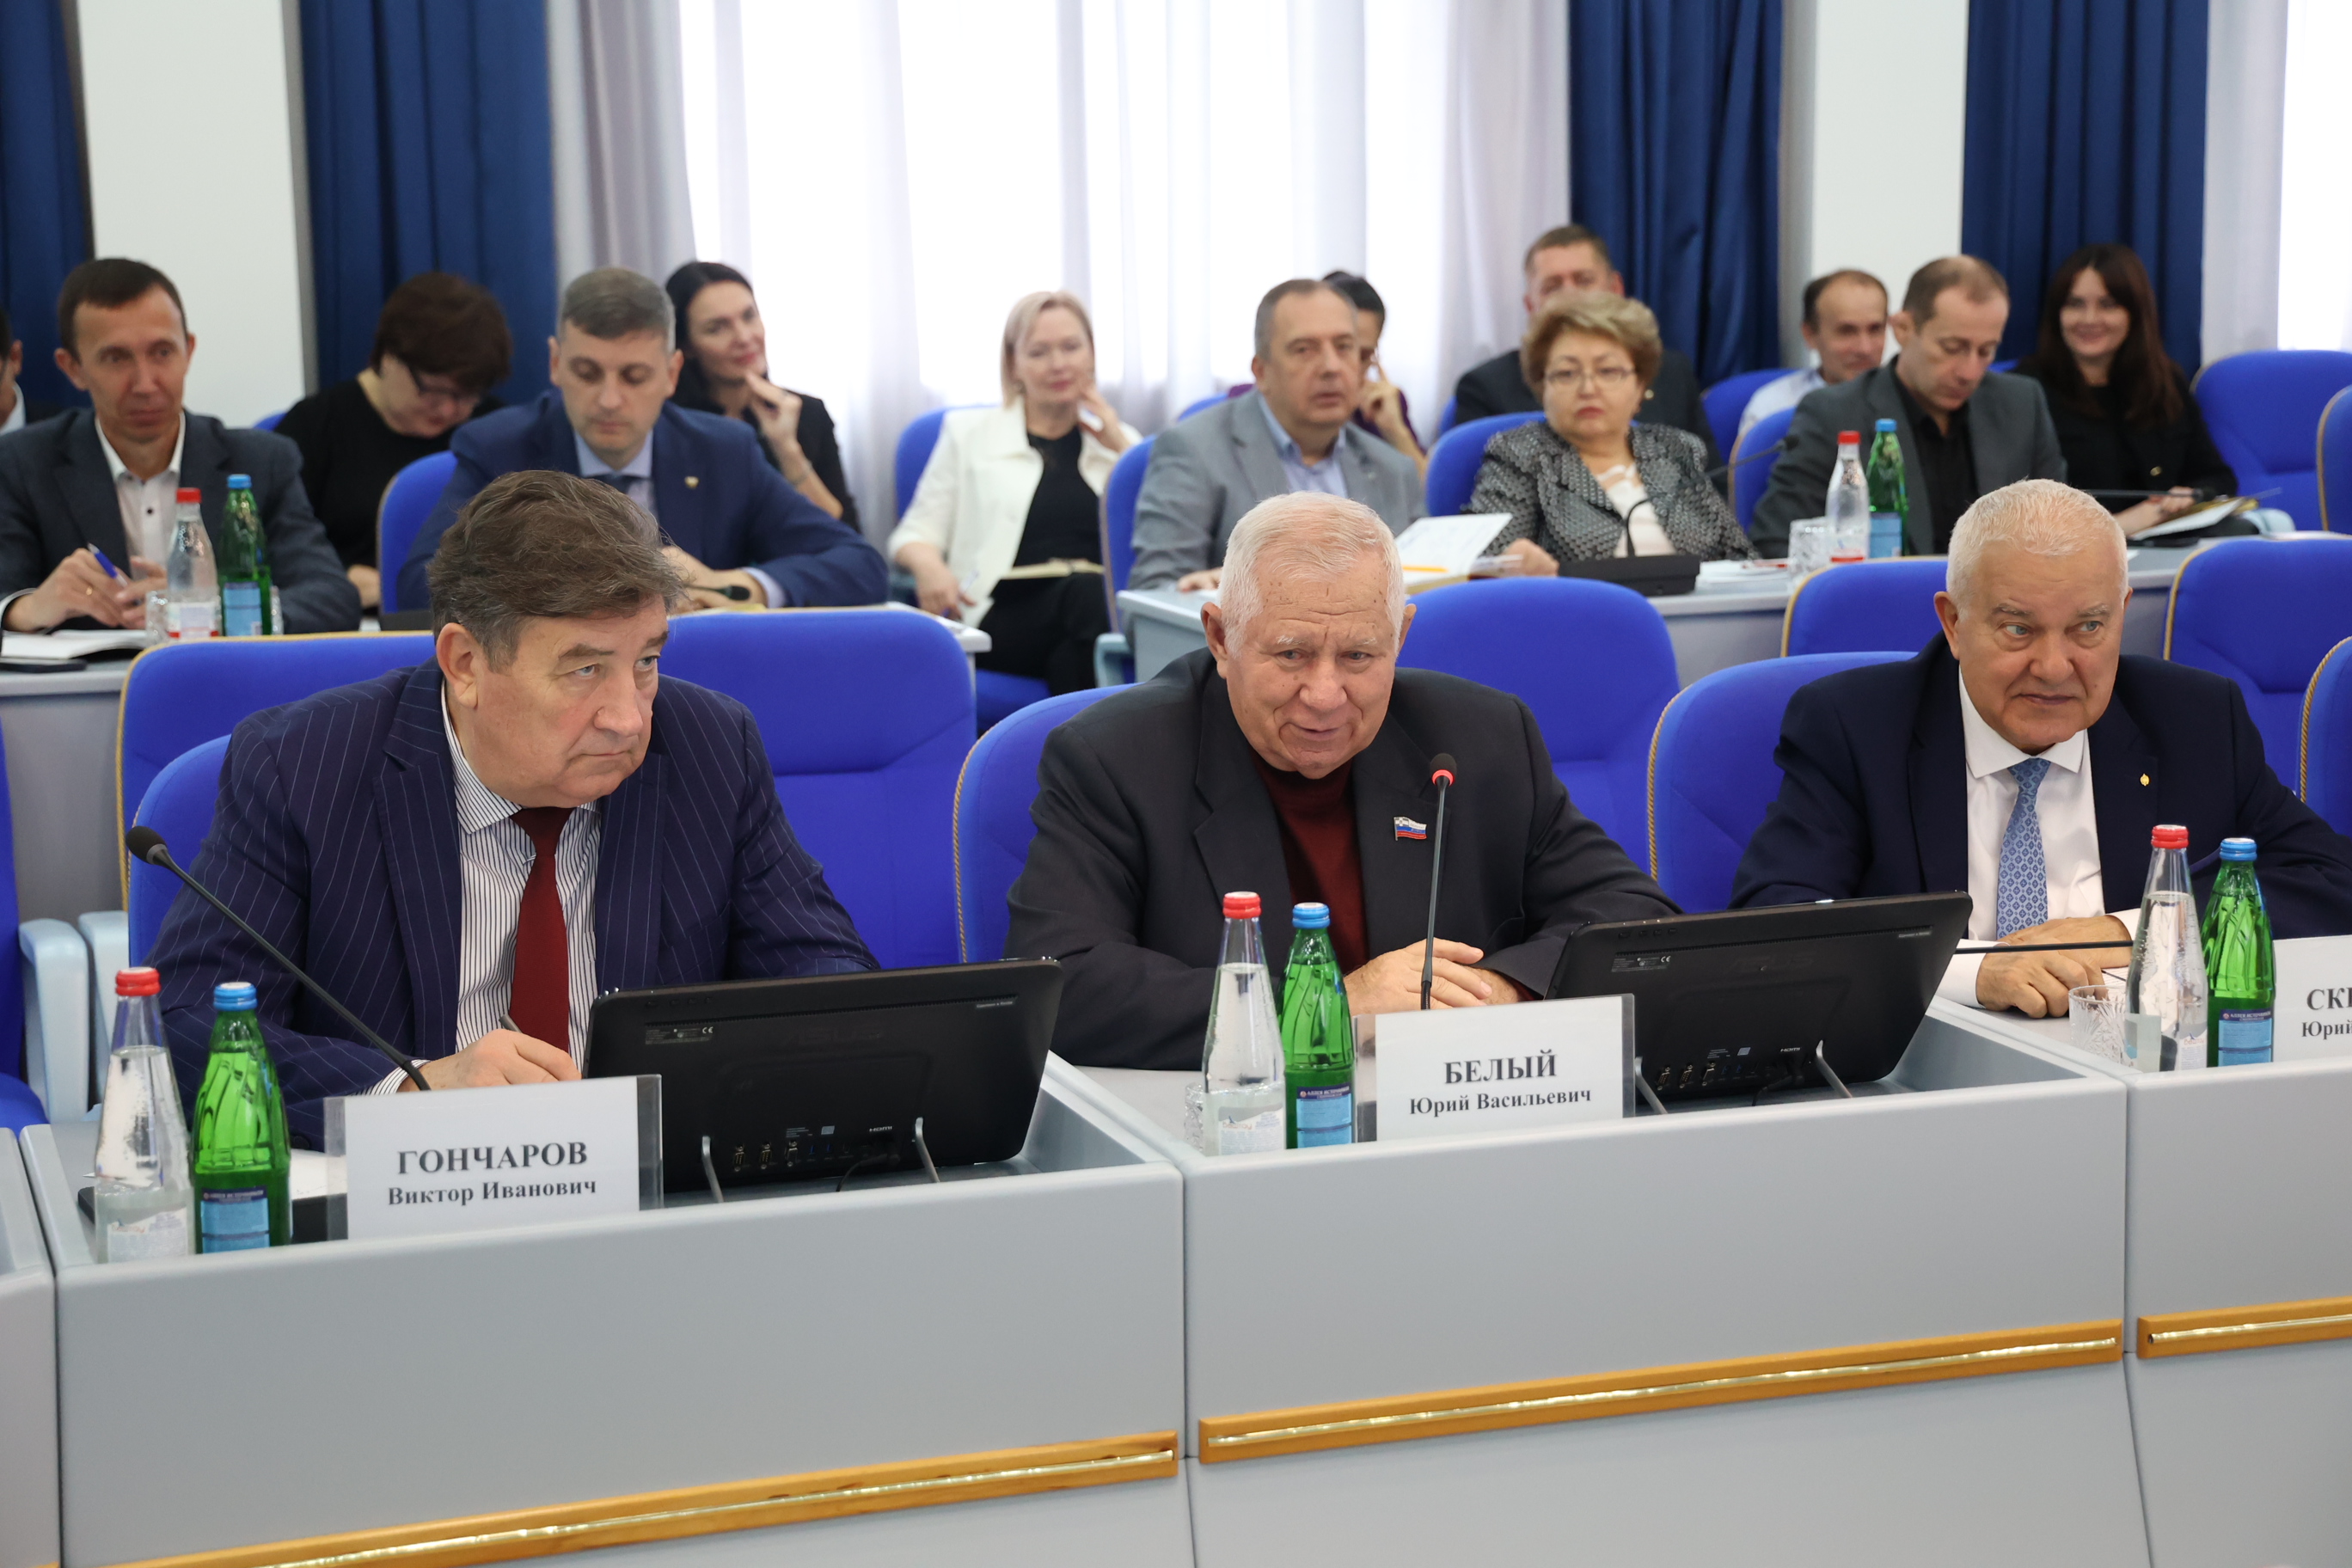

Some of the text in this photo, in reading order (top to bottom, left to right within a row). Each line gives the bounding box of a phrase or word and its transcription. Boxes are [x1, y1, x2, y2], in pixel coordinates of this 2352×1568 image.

[1444, 1049, 1557, 1084] БЕЛЫЙ
[1410, 1090, 1591, 1118] Юрий Васильевич
[398, 1142, 588, 1174] ГОНЧАРОВ
[388, 1180, 597, 1206] Виктор Иванович
